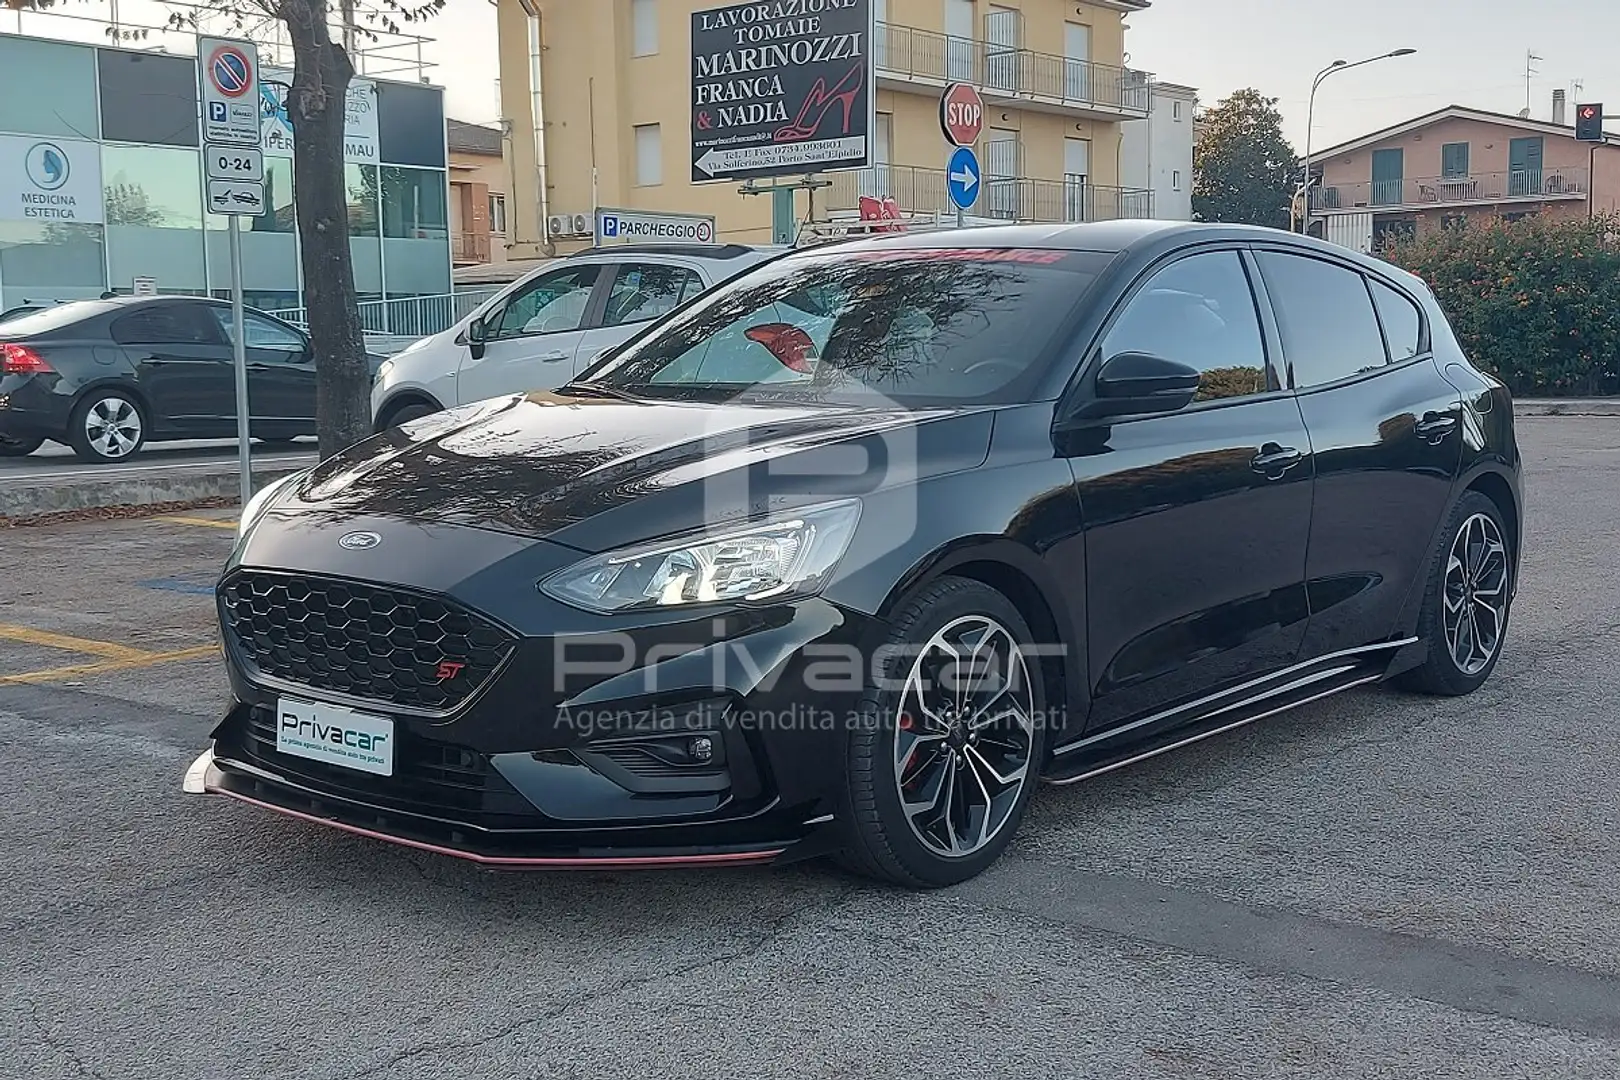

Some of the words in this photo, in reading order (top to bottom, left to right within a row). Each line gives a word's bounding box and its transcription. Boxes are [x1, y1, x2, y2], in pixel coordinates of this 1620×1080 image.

[733, 16, 821, 45] TOMAIE
[695, 32, 863, 78] MARINOZZI
[695, 74, 785, 105] FRANCA
[212, 103, 225, 120] P
[697, 110, 712, 130] &
[717, 100, 789, 128] NADIA
[948, 102, 980, 127] STOP
[345, 143, 374, 157] MAU
[754, 147, 772, 157] Fax
[218, 156, 252, 171] 0-24
[708, 161, 721, 171] Via
[778, 155, 803, 164] Porto
[21, 193, 76, 206] MEDICINA
[24, 206, 75, 219] ESTETICA
[606, 219, 616, 235] P
[619, 221, 696, 238] PARCHEGGIO
[436, 662, 466, 679] ST
[282, 712, 388, 752] Privacar
